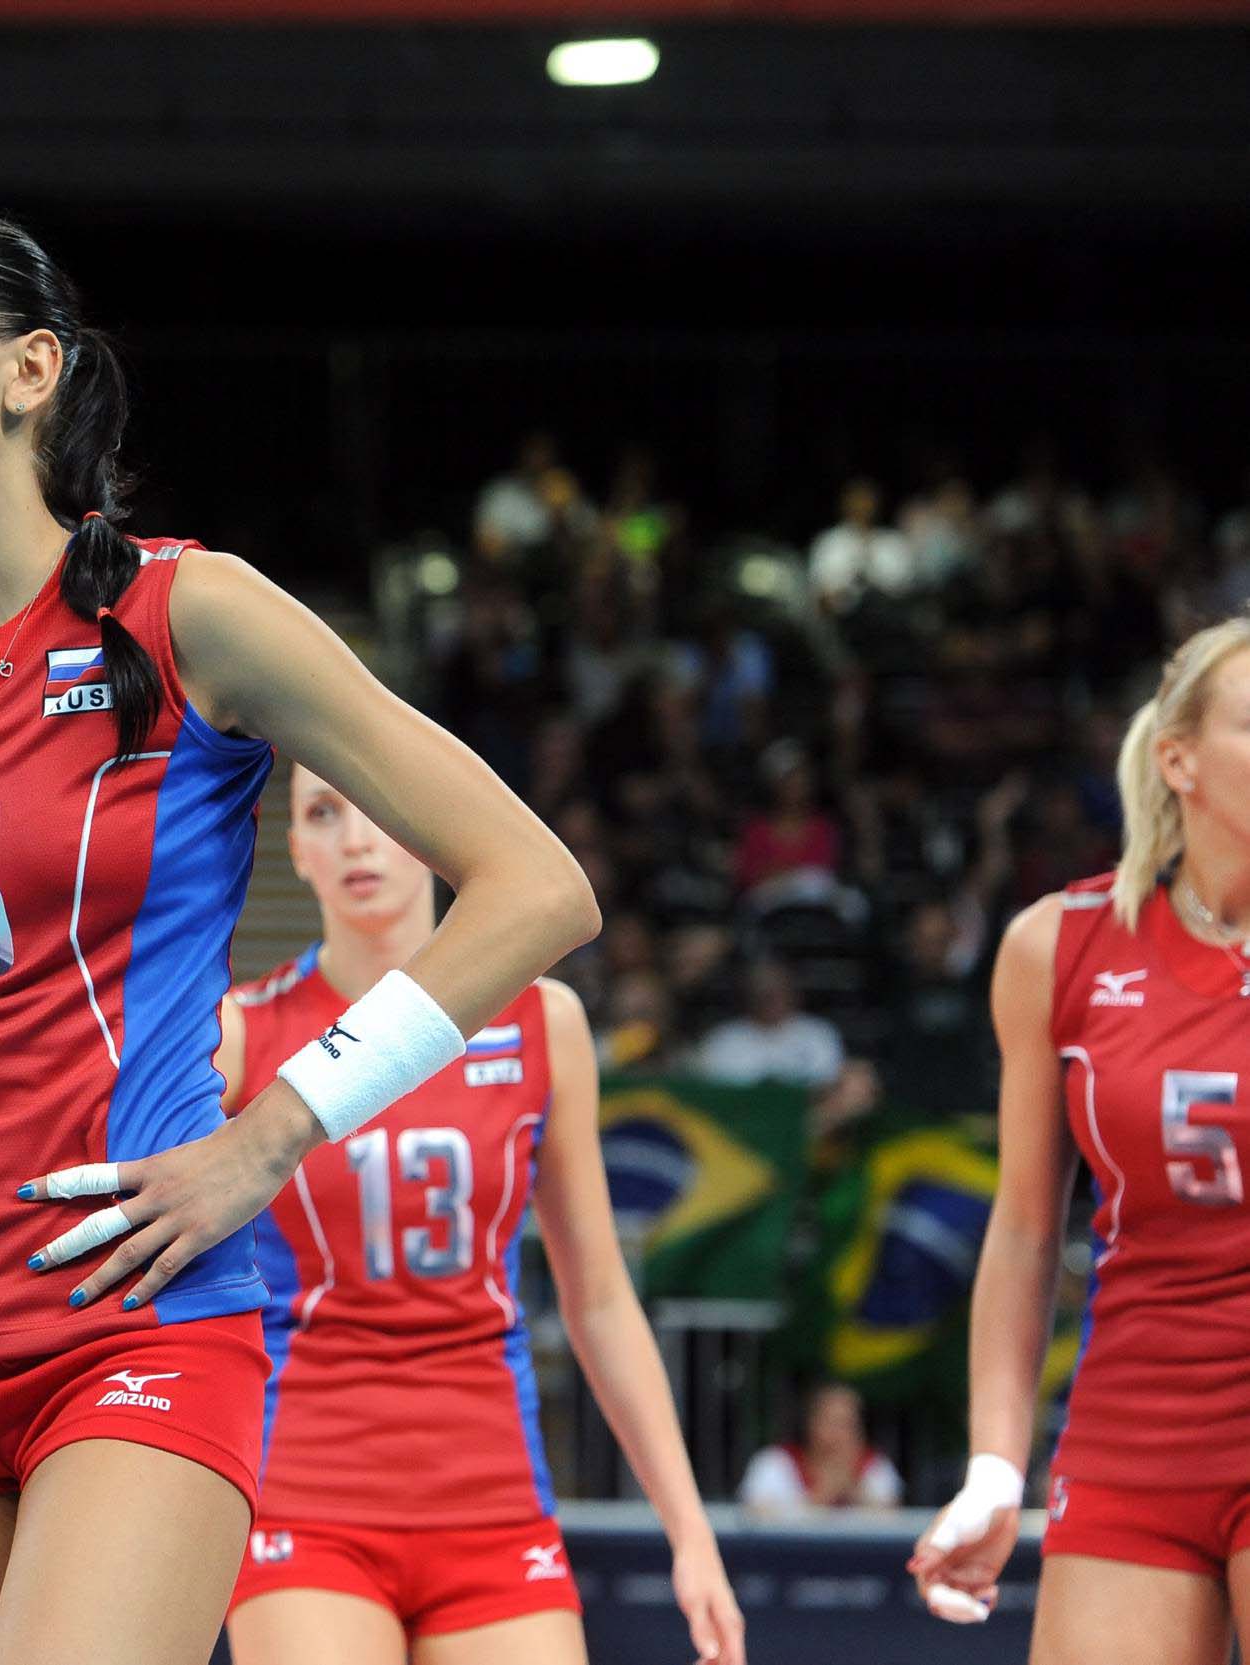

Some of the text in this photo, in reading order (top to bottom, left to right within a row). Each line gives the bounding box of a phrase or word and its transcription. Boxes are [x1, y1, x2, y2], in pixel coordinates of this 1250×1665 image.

[346, 1127, 475, 1281] 13
[1161, 1069, 1244, 1206] 5
[95, 1390, 171, 1411] MIZUNO
